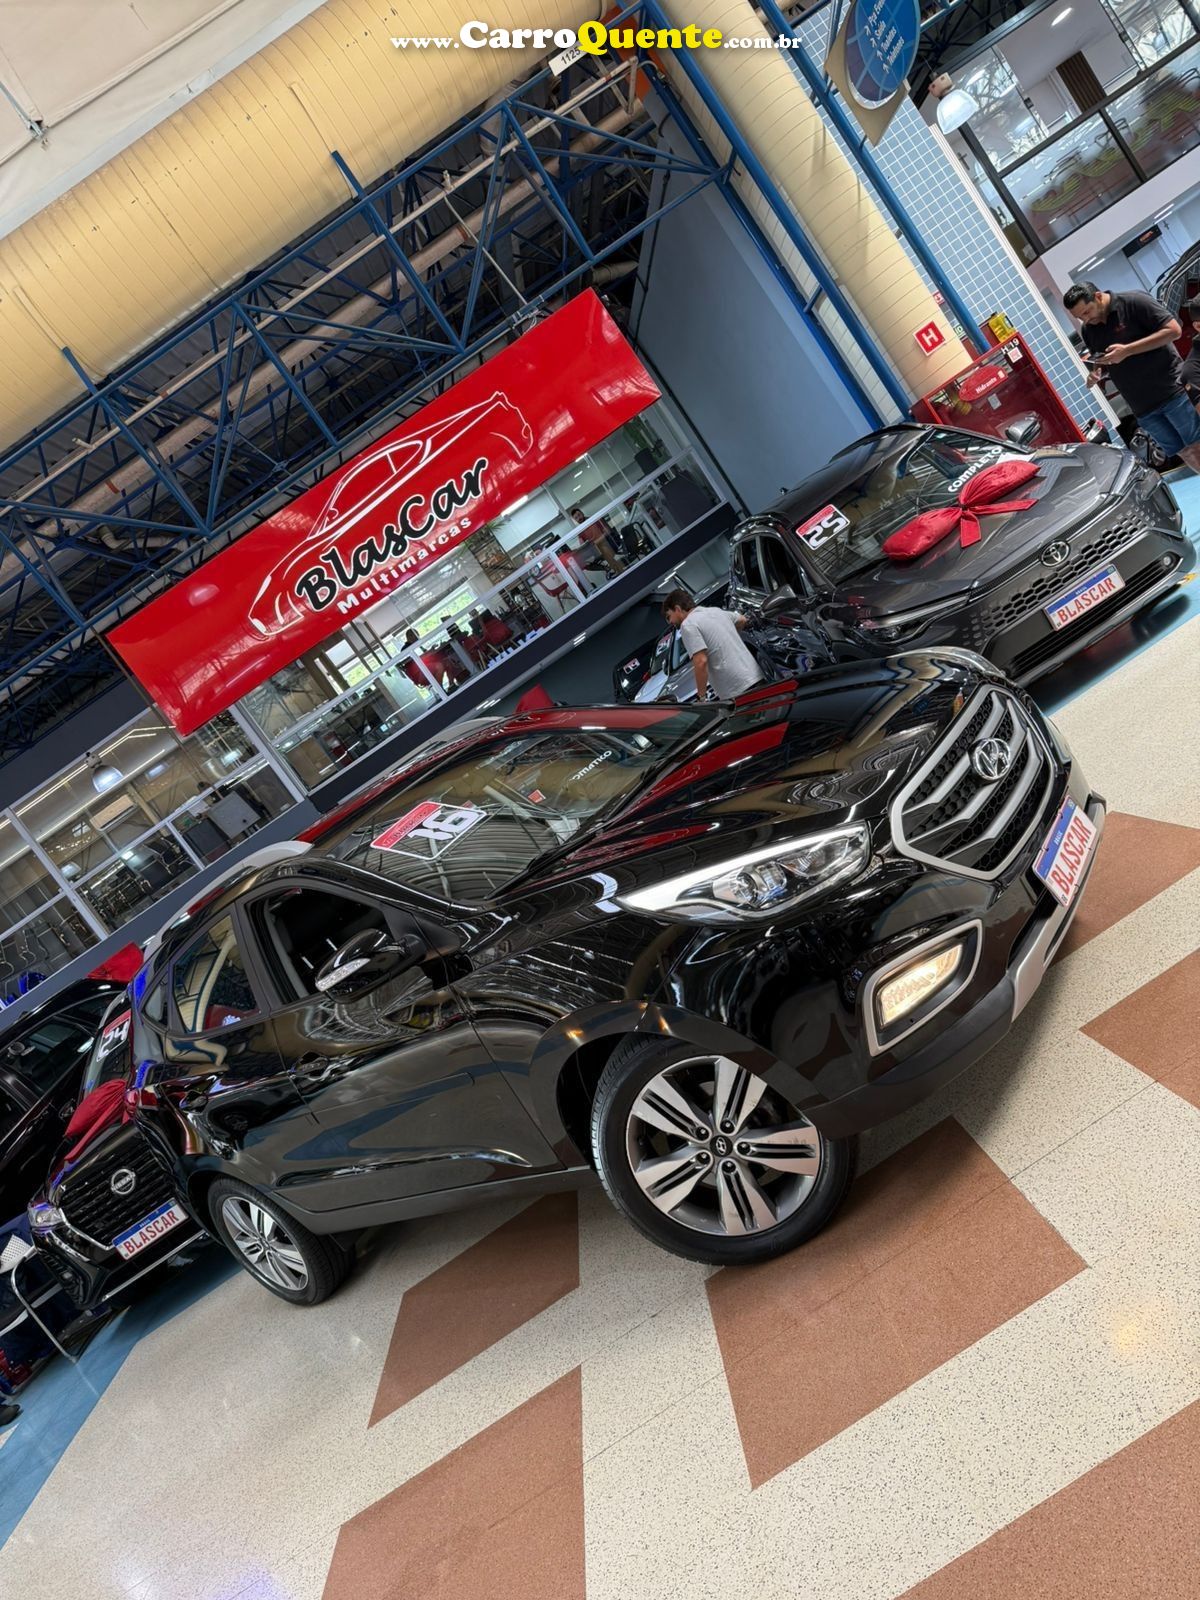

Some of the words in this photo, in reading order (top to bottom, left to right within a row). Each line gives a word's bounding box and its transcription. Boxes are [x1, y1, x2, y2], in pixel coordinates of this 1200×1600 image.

[921, 328, 939, 347] H
[975, 376, 998, 394] Hidrante
[295, 457, 488, 612] BlasCar
[804, 512, 847, 547] 25
[336, 517, 472, 615] Multimarcas
[1056, 576, 1117, 623] BLASCAR
[407, 809, 481, 841] 16
[1050, 815, 1092, 896] BLASCAR
[98, 1020, 129, 1058] 24
[122, 1209, 180, 1255] BLASCAR
